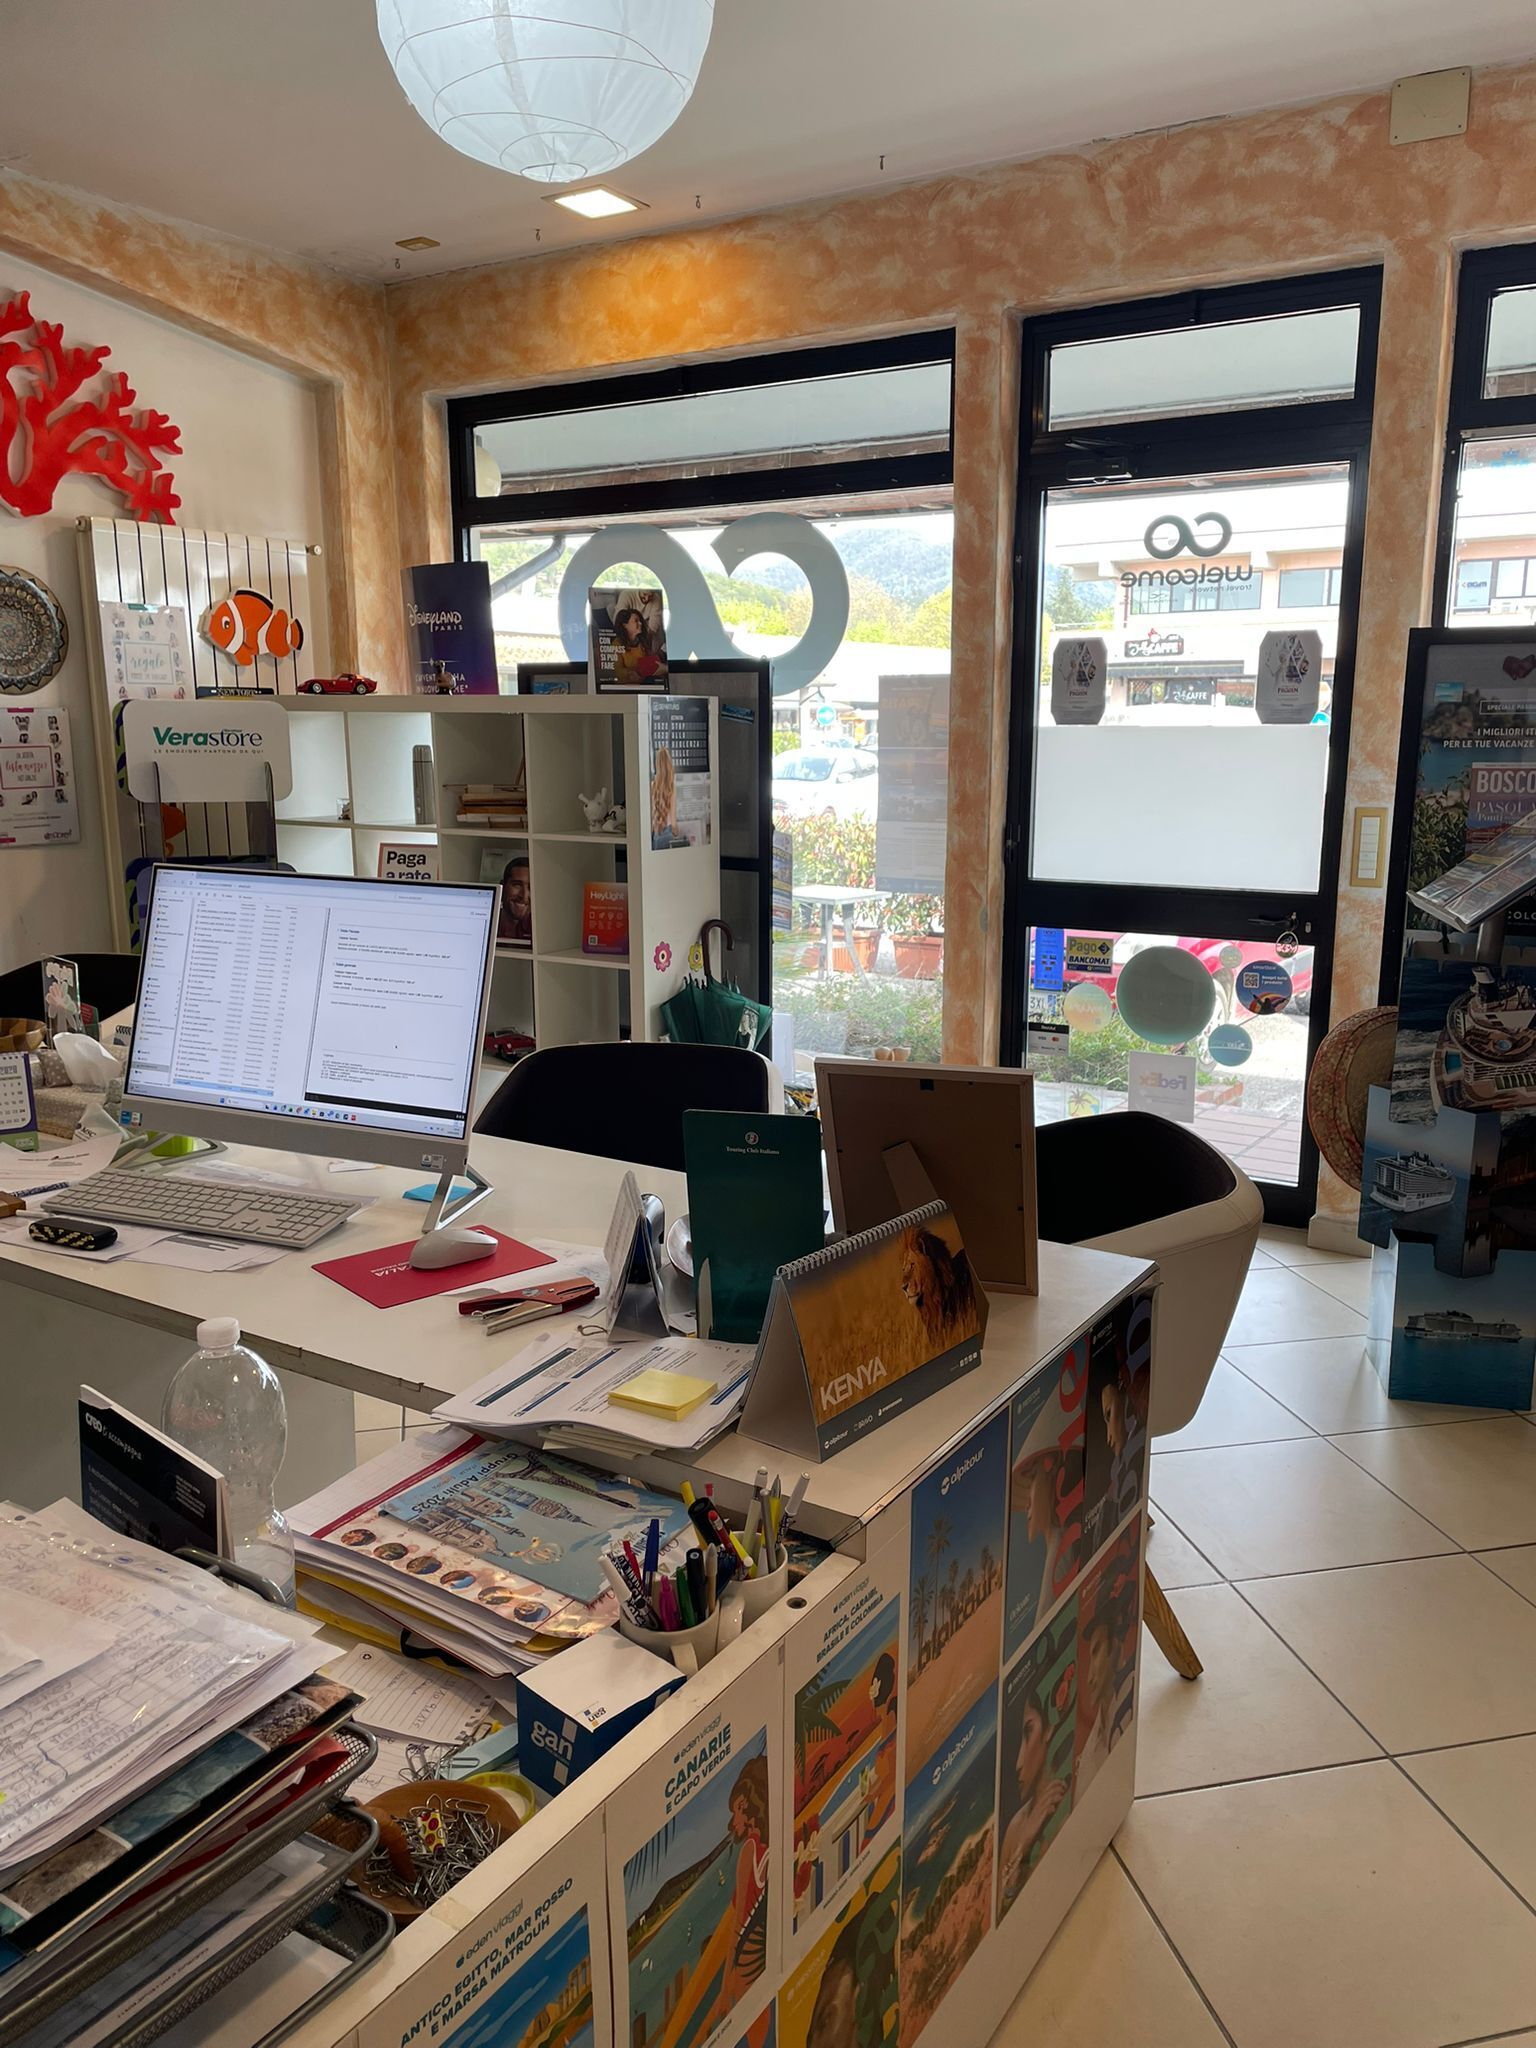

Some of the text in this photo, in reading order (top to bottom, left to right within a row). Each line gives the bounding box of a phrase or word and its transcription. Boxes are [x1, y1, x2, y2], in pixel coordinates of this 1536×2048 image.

[601, 662, 615, 670] FARE
[153, 727, 263, 746] Verastore
[1483, 728, 1524, 736] MIGLIORI
[1443, 740, 1535, 748] PER LE TUE VACANZE
[386, 851, 426, 868] Paga
[386, 869, 431, 880] a rate
[590, 891, 625, 901] HeyLight
[1070, 940, 1097, 954] Pago
[1069, 956, 1110, 965] BANCOMAT
[820, 1356, 888, 1411] KENYA
[478, 1452, 518, 1477] Gruppi
[950, 1447, 985, 1485] alpitour
[443, 1475, 479, 1497] Adulti
[411, 1494, 445, 1513] 2025
[531, 1721, 573, 1761] gan
[942, 1725, 976, 1772] alpitour
[664, 1723, 731, 1798] CANARIE
[666, 1743, 731, 1815] E CAPO VERDE
[465, 1899, 524, 1960] eden viaggi
[401, 1878, 573, 2048] ANTICO EGITTO, MAR ROSSO
[430, 1915, 550, 2037] E MARSA MATROUH
